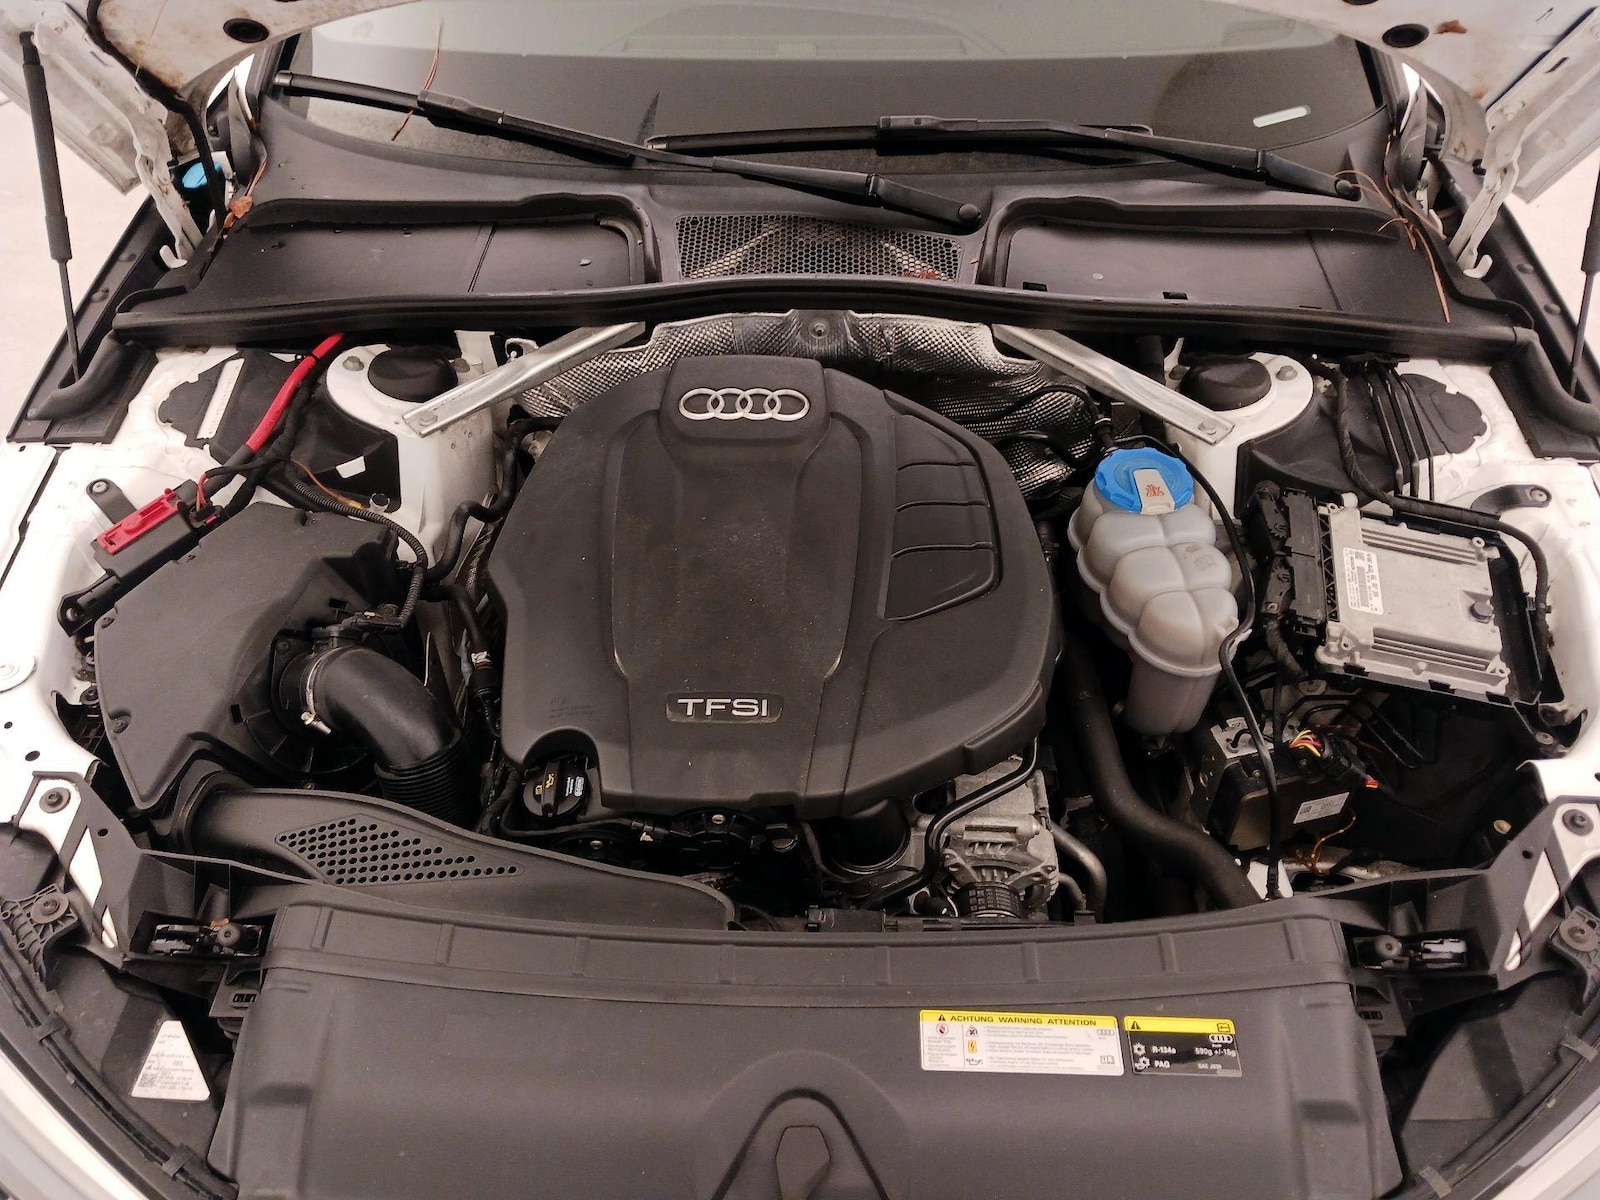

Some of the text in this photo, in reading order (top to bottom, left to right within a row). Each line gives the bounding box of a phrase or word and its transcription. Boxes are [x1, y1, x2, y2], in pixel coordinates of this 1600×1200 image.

[677, 698, 768, 717] TFSI
[950, 1015, 1097, 1026] ACHTUNG WARNING ATTENTION
[1152, 1045, 1177, 1054] R-134a
[1154, 1060, 1171, 1068] PAG
